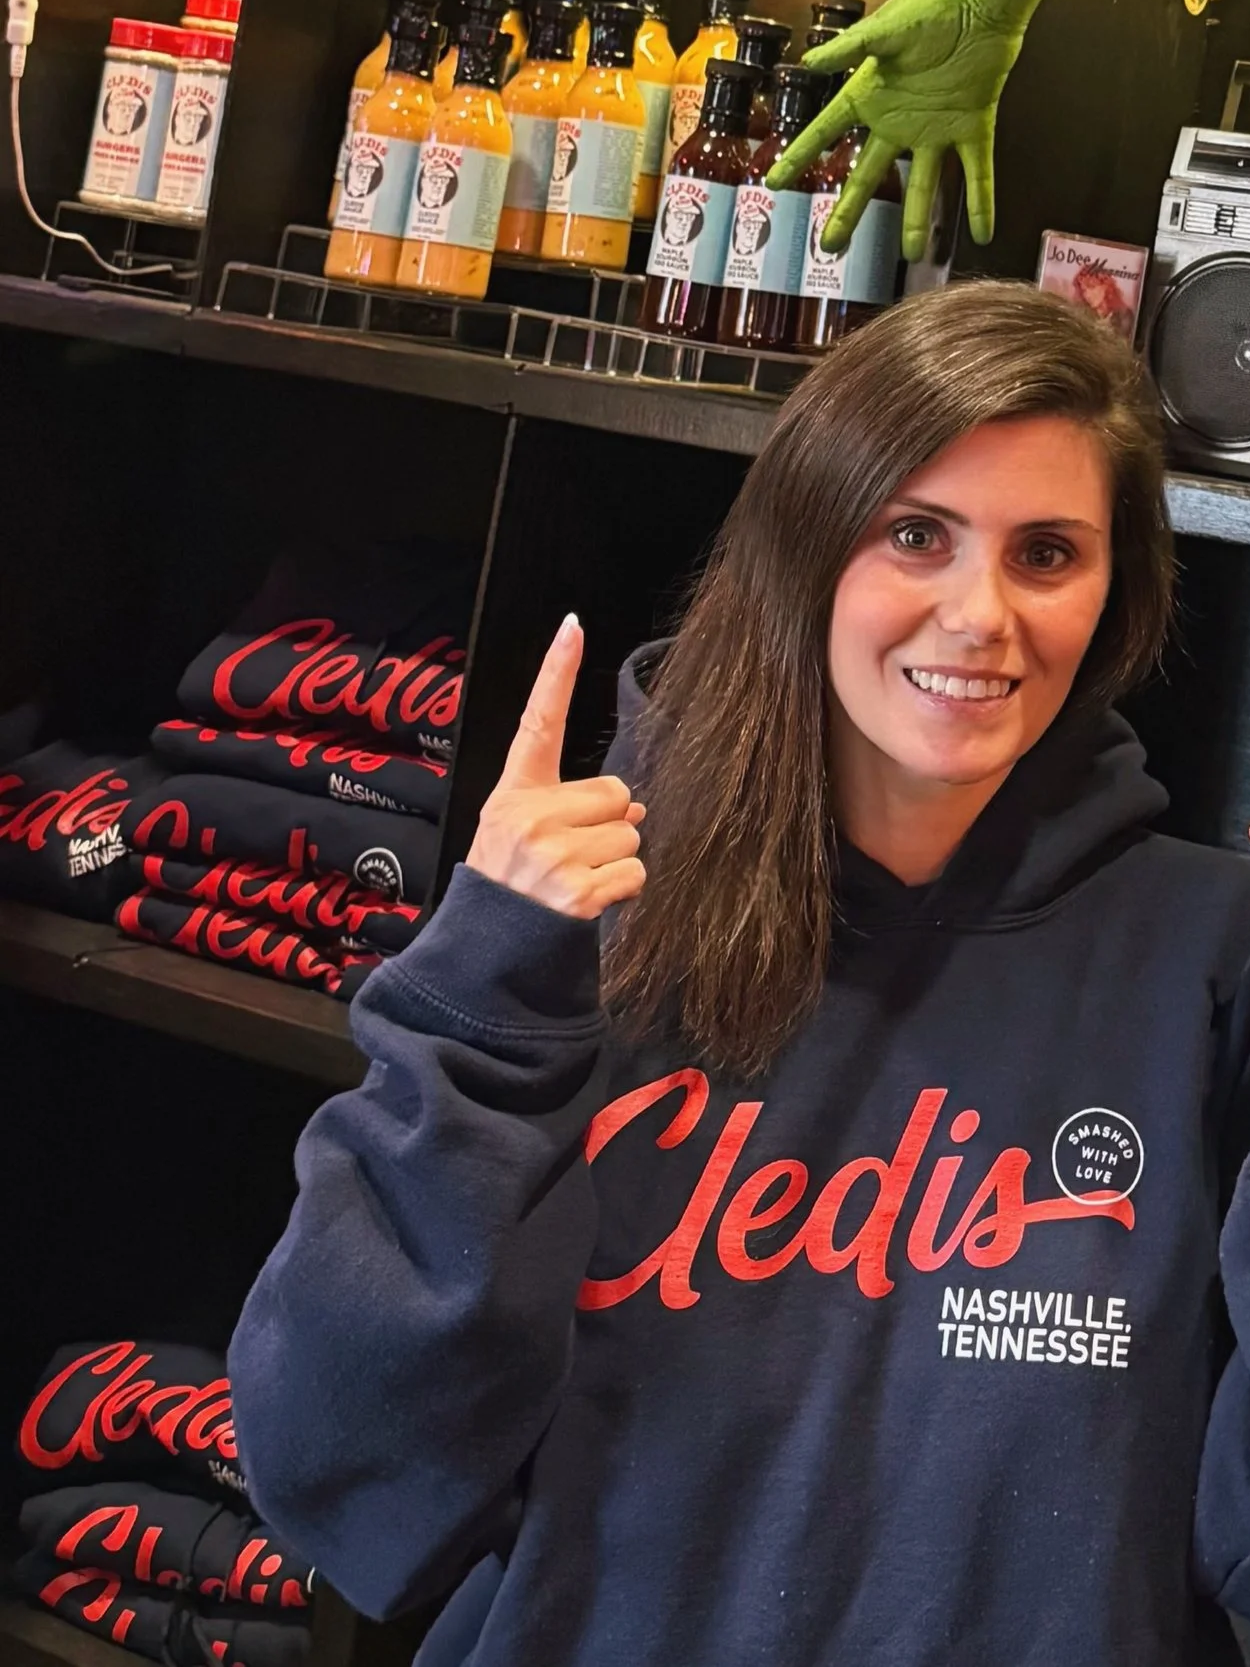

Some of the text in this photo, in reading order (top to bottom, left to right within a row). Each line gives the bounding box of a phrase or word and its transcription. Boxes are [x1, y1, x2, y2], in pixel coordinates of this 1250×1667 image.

[1047, 245, 1065, 263] Jo
[1067, 248, 1091, 266] Dee
[213, 618, 467, 732] Cledis
[361, 857, 397, 885] SMASHED
[1068, 1124, 1134, 1159] SMASHED
[1081, 1145, 1118, 1166] WITH
[576, 1067, 1136, 1314] Cledis
[1075, 1165, 1113, 1184] LOVE
[941, 1286, 1132, 1333] NASHVILLE,
[937, 1323, 1132, 1368] TENNESSEE
